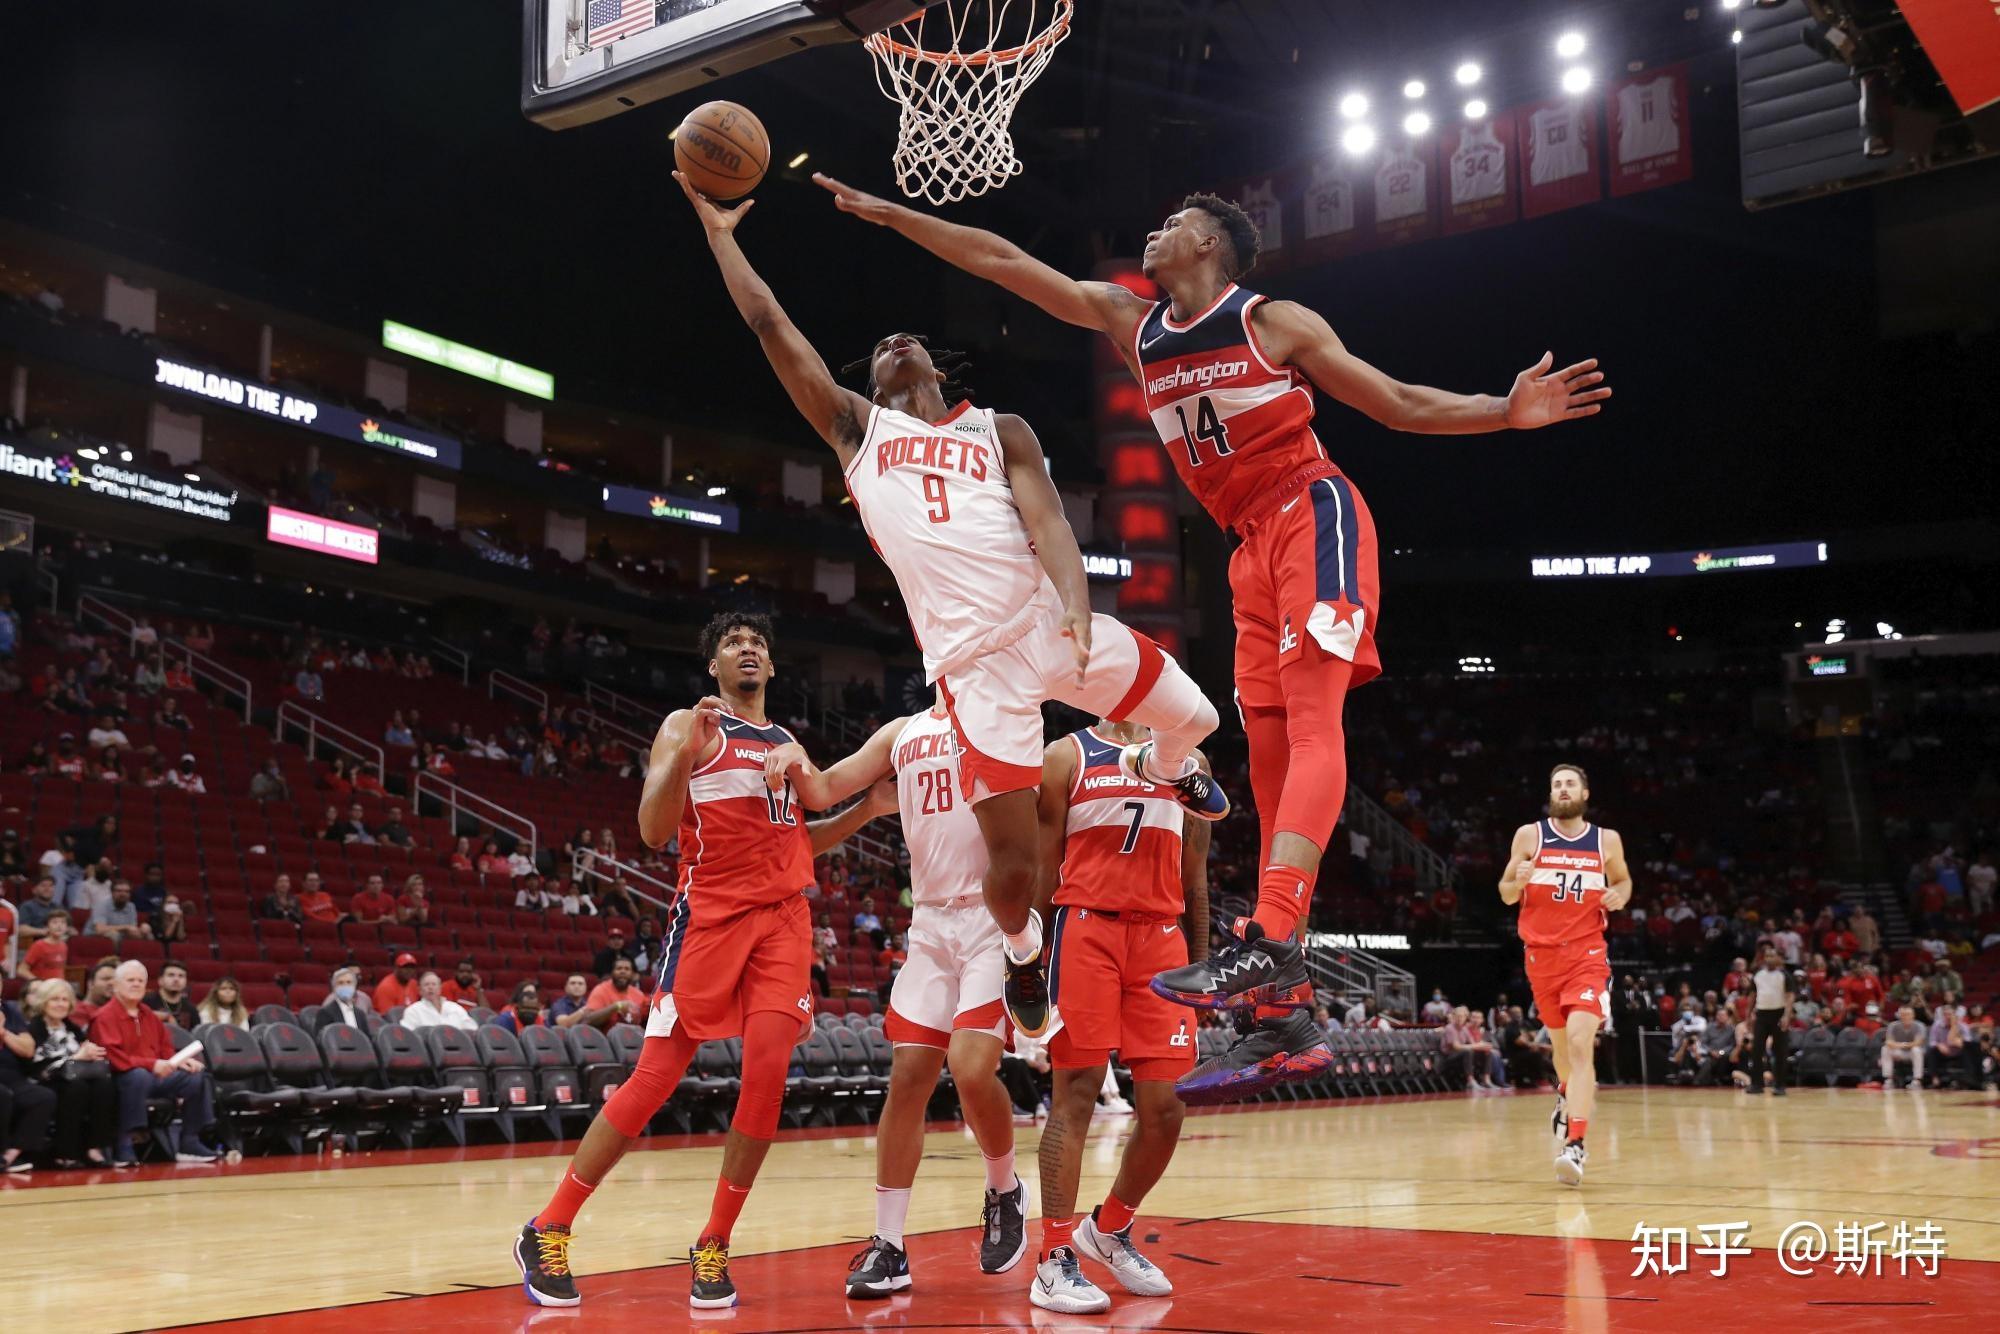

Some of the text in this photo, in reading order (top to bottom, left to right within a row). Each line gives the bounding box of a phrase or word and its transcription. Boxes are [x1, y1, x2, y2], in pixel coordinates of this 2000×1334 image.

[1464, 154, 1490, 178] 34
[1388, 173, 1411, 195] 22
[1315, 189, 1341, 214] 24
[1148, 361, 1249, 395] washington
[246, 384, 281, 416] THE
[281, 396, 318, 424] APP
[954, 425, 988, 434] MONEY
[1175, 395, 1236, 467] 14
[878, 436, 989, 483] ROCKETS
[91, 463, 230, 507] Official Energy Provider
[922, 473, 951, 524] 9
[1585, 557, 1616, 574] THE
[1618, 556, 1651, 574] APP
[917, 768, 953, 815] 28
[1119, 801, 1146, 854] 7
[1541, 853, 1599, 868] washington
[1552, 872, 1584, 904] 34
[1357, 933, 1412, 950] TUNNEL
